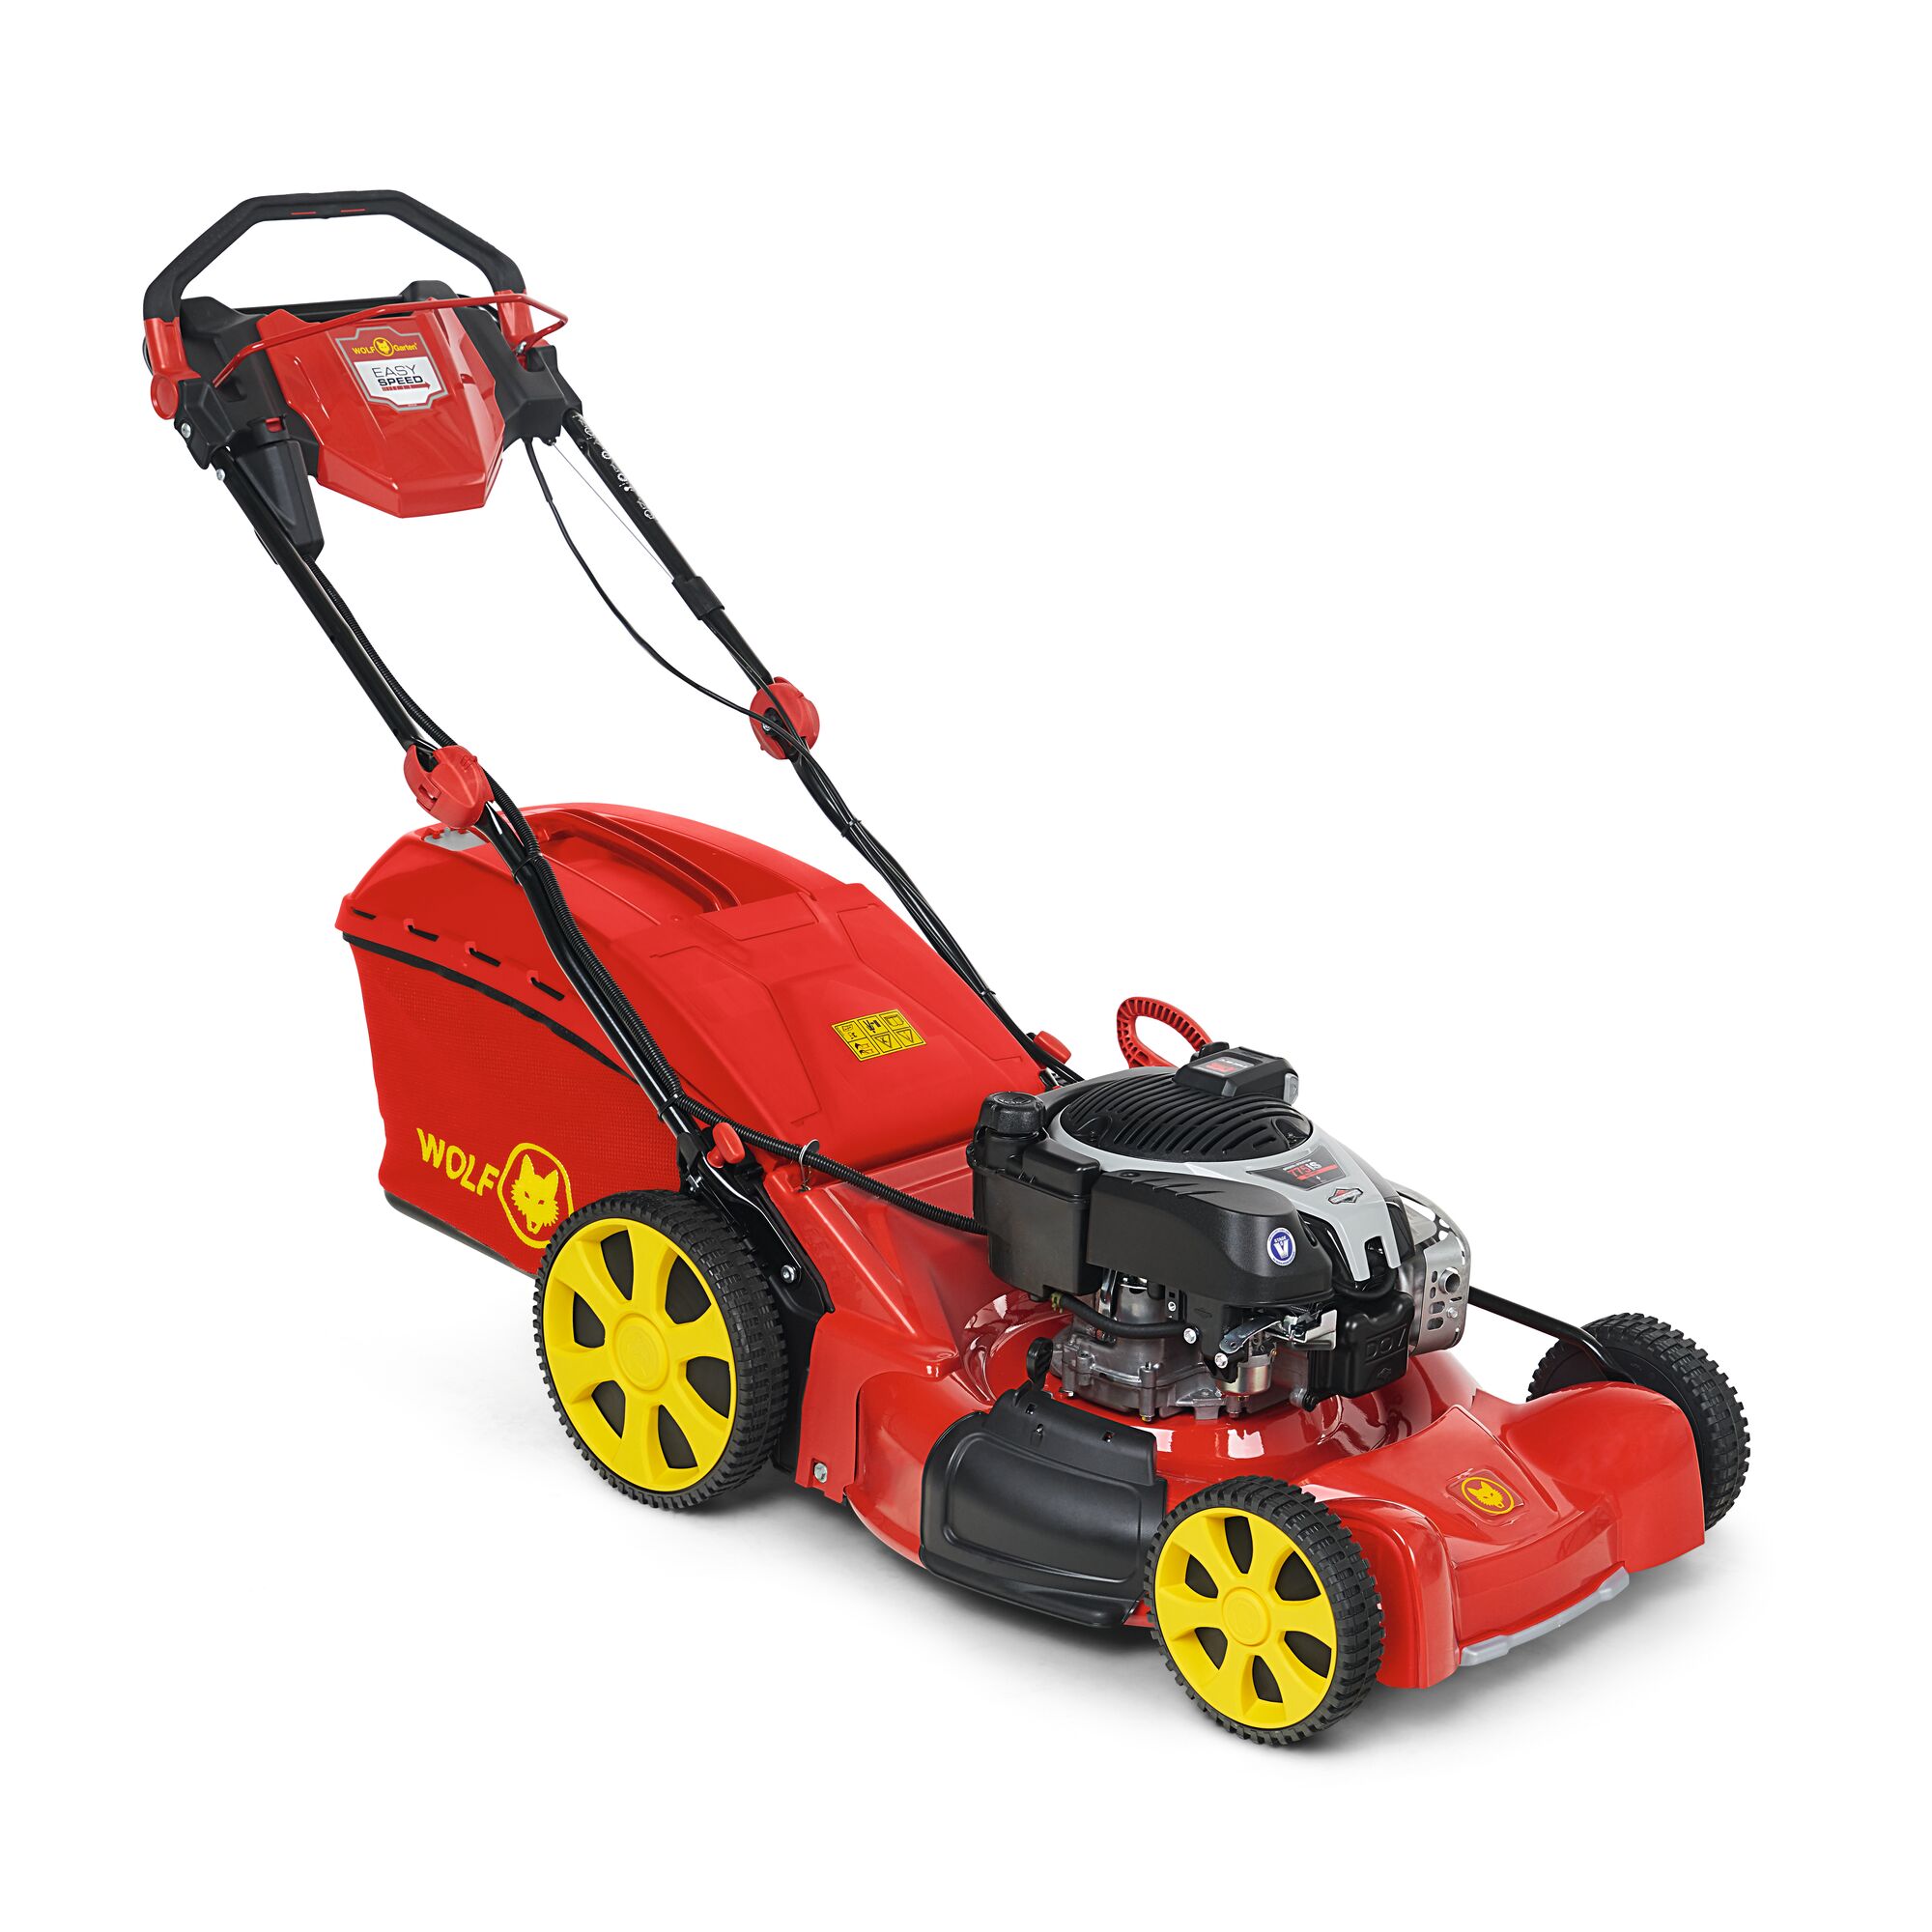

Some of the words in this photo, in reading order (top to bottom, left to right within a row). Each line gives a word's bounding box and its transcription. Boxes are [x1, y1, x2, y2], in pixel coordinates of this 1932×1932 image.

[352, 346, 376, 355] WOLF
[371, 364, 416, 378] EASY
[378, 375, 423, 386] SPEED
[416, 1127, 500, 1196] WOLF
